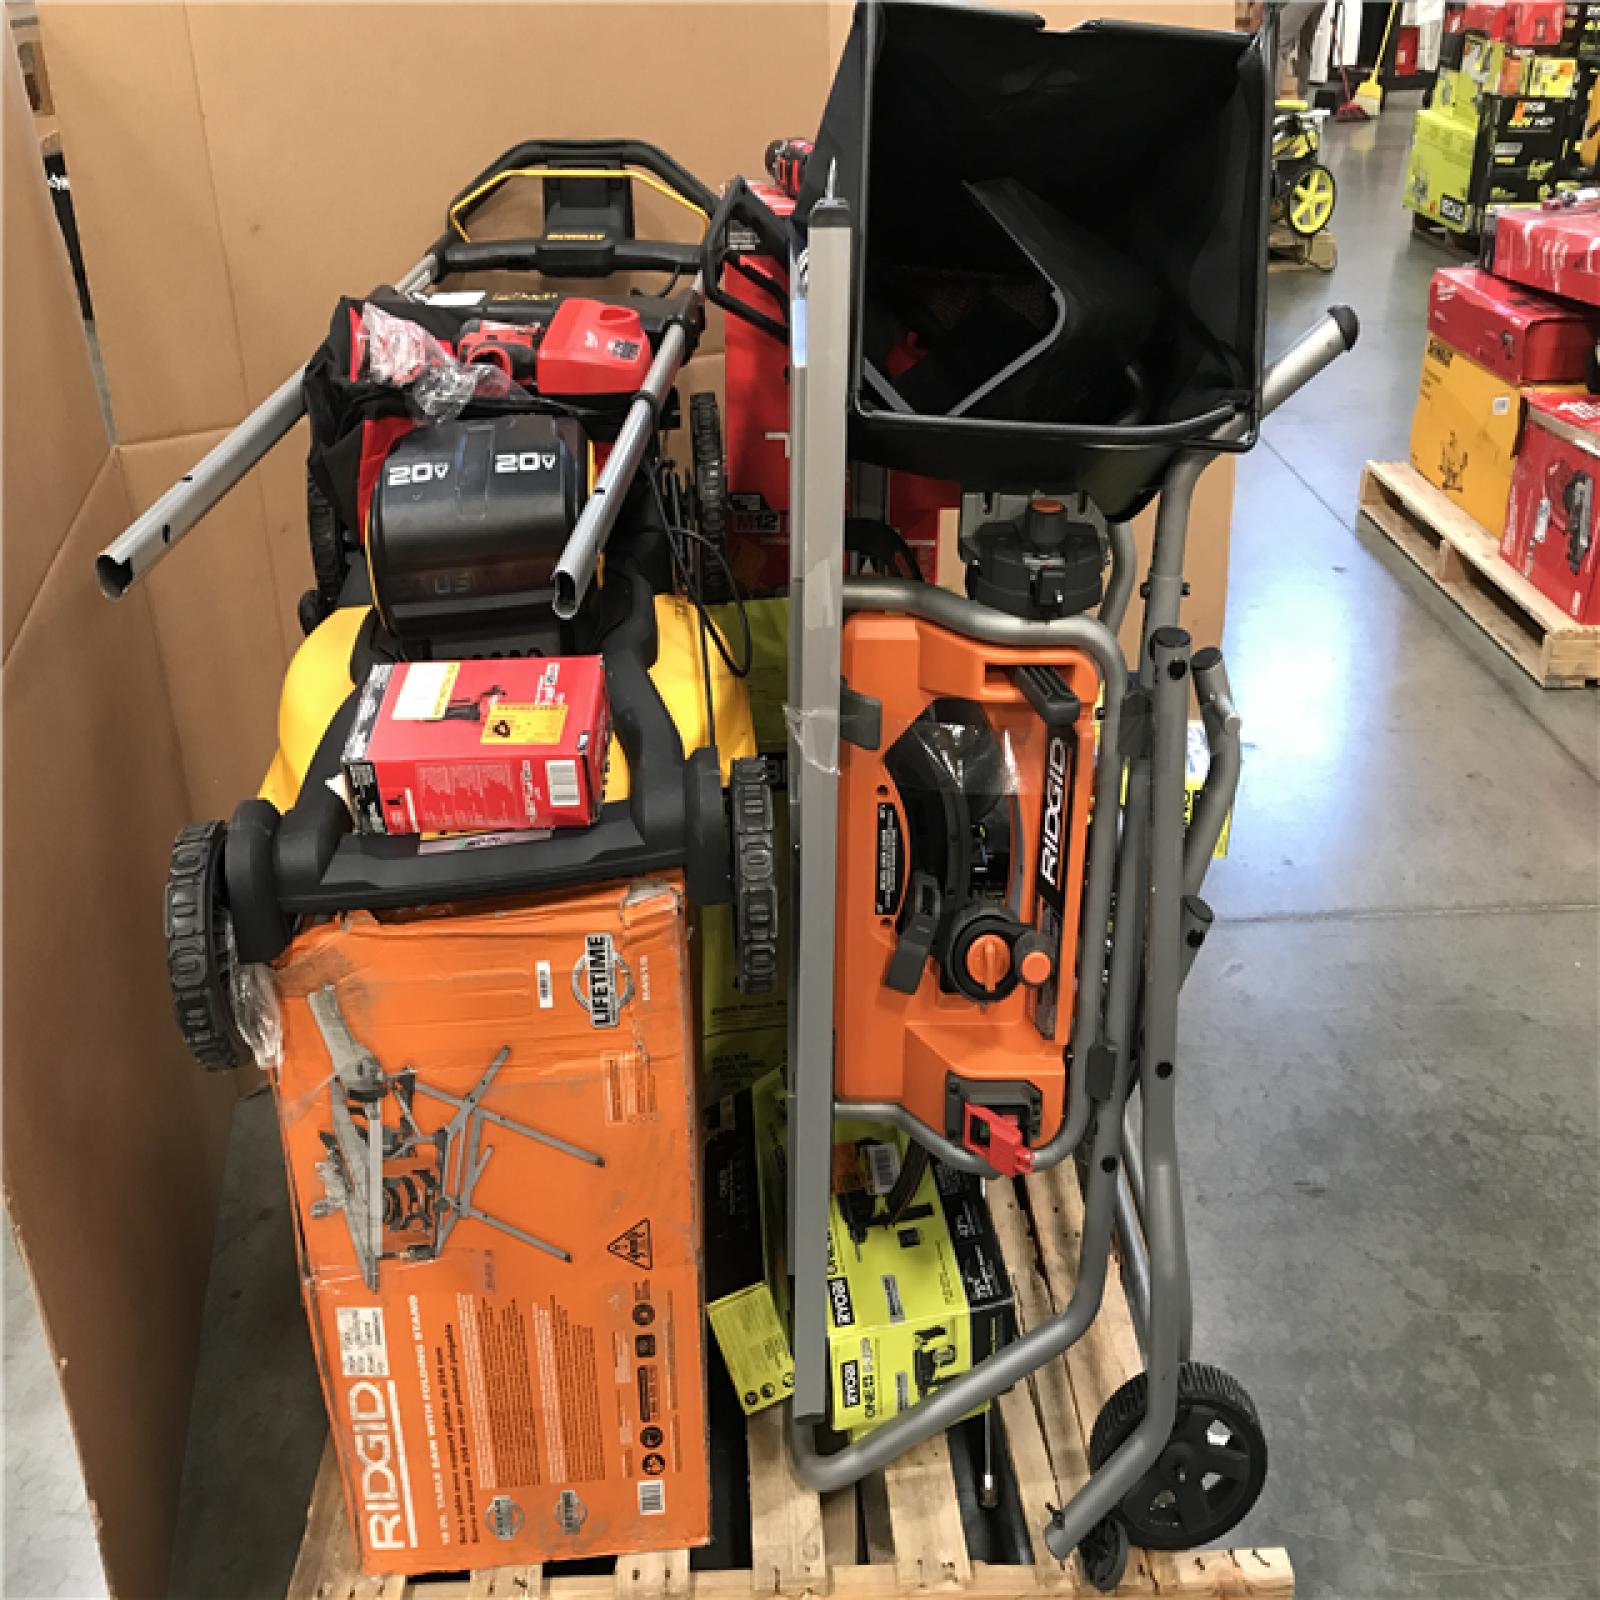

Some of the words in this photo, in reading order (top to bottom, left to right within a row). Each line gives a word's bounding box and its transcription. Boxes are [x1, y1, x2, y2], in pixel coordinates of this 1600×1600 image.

[1040, 737, 1066, 886] RIDGID
[587, 936, 611, 1026] LIFETIME
[408, 1294, 424, 1340] STAND
[415, 1344, 431, 1400] FOLDING
[424, 1404, 436, 1436] WITH
[348, 1380, 406, 1549] RIDGID
[429, 1440, 440, 1468] SAW
[433, 1472, 446, 1508] TABLE
